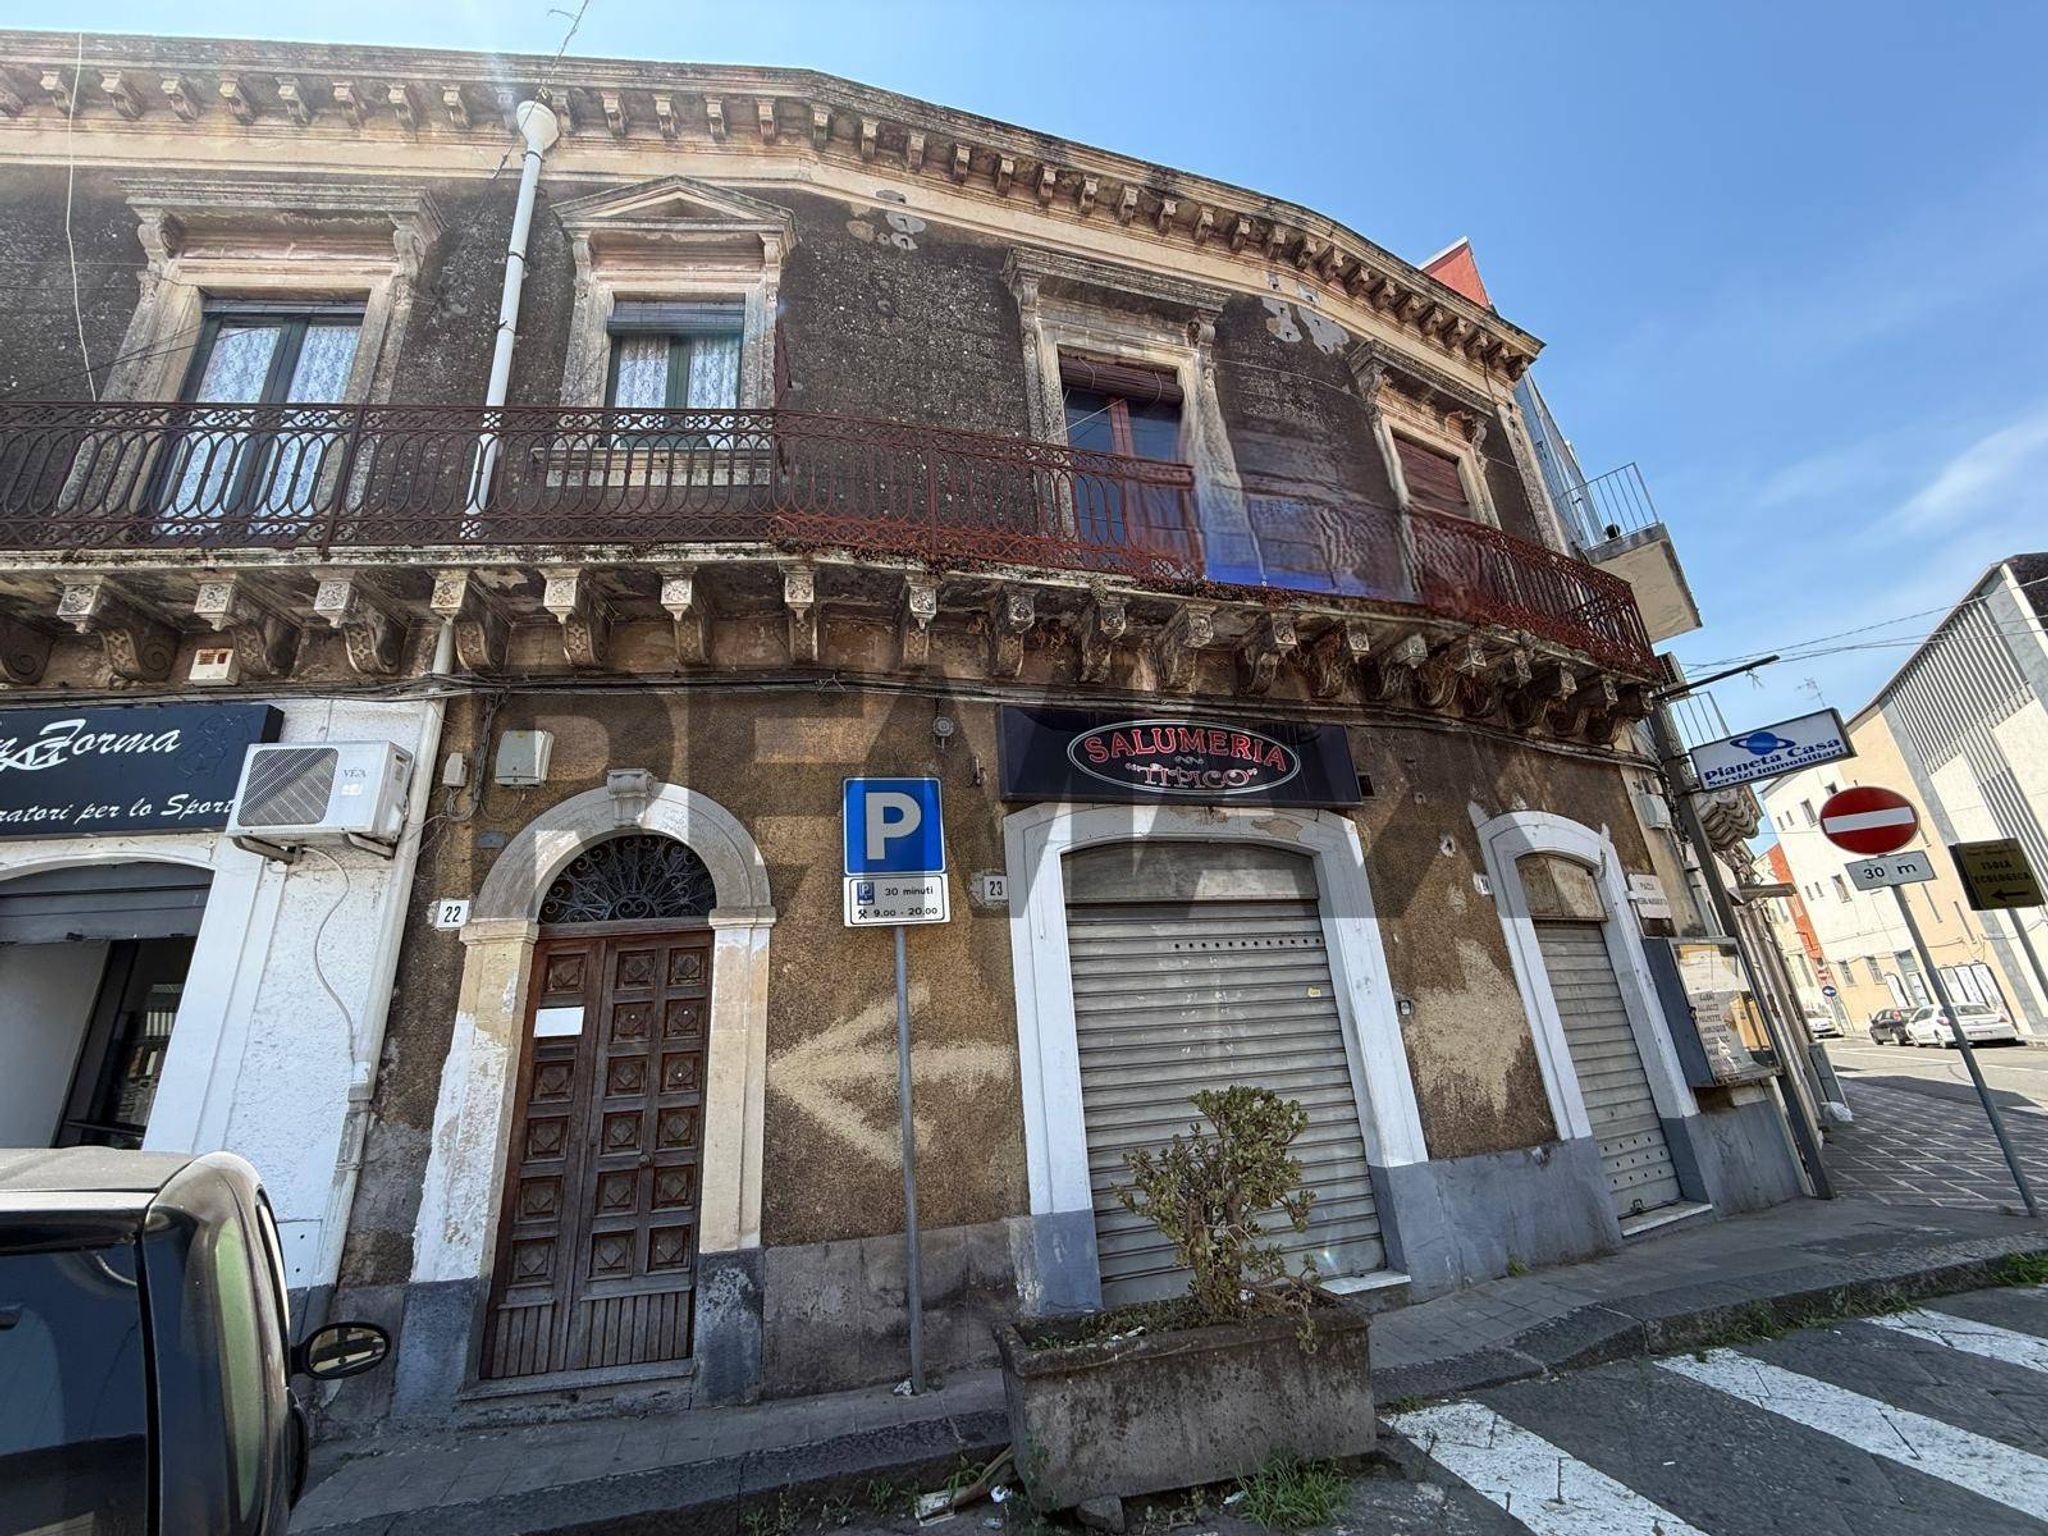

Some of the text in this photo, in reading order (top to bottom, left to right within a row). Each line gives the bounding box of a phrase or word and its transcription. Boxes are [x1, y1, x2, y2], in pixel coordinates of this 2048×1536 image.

[1084, 727, 1287, 772] SALUMERIA
[1704, 738, 1841, 781] Pianeta Casa
[1708, 770, 1754, 787] Servizi
[74, 803, 121, 825] per
[129, 798, 152, 817] lo
[866, 792, 921, 860] P
[1863, 863, 1917, 880] 30 m
[885, 886, 933, 896] 30 minuti
[989, 880, 1003, 896] 23
[444, 906, 461, 923] 22
[873, 908, 896, 918] 9.00
[908, 907, 938, 916] 20.00
